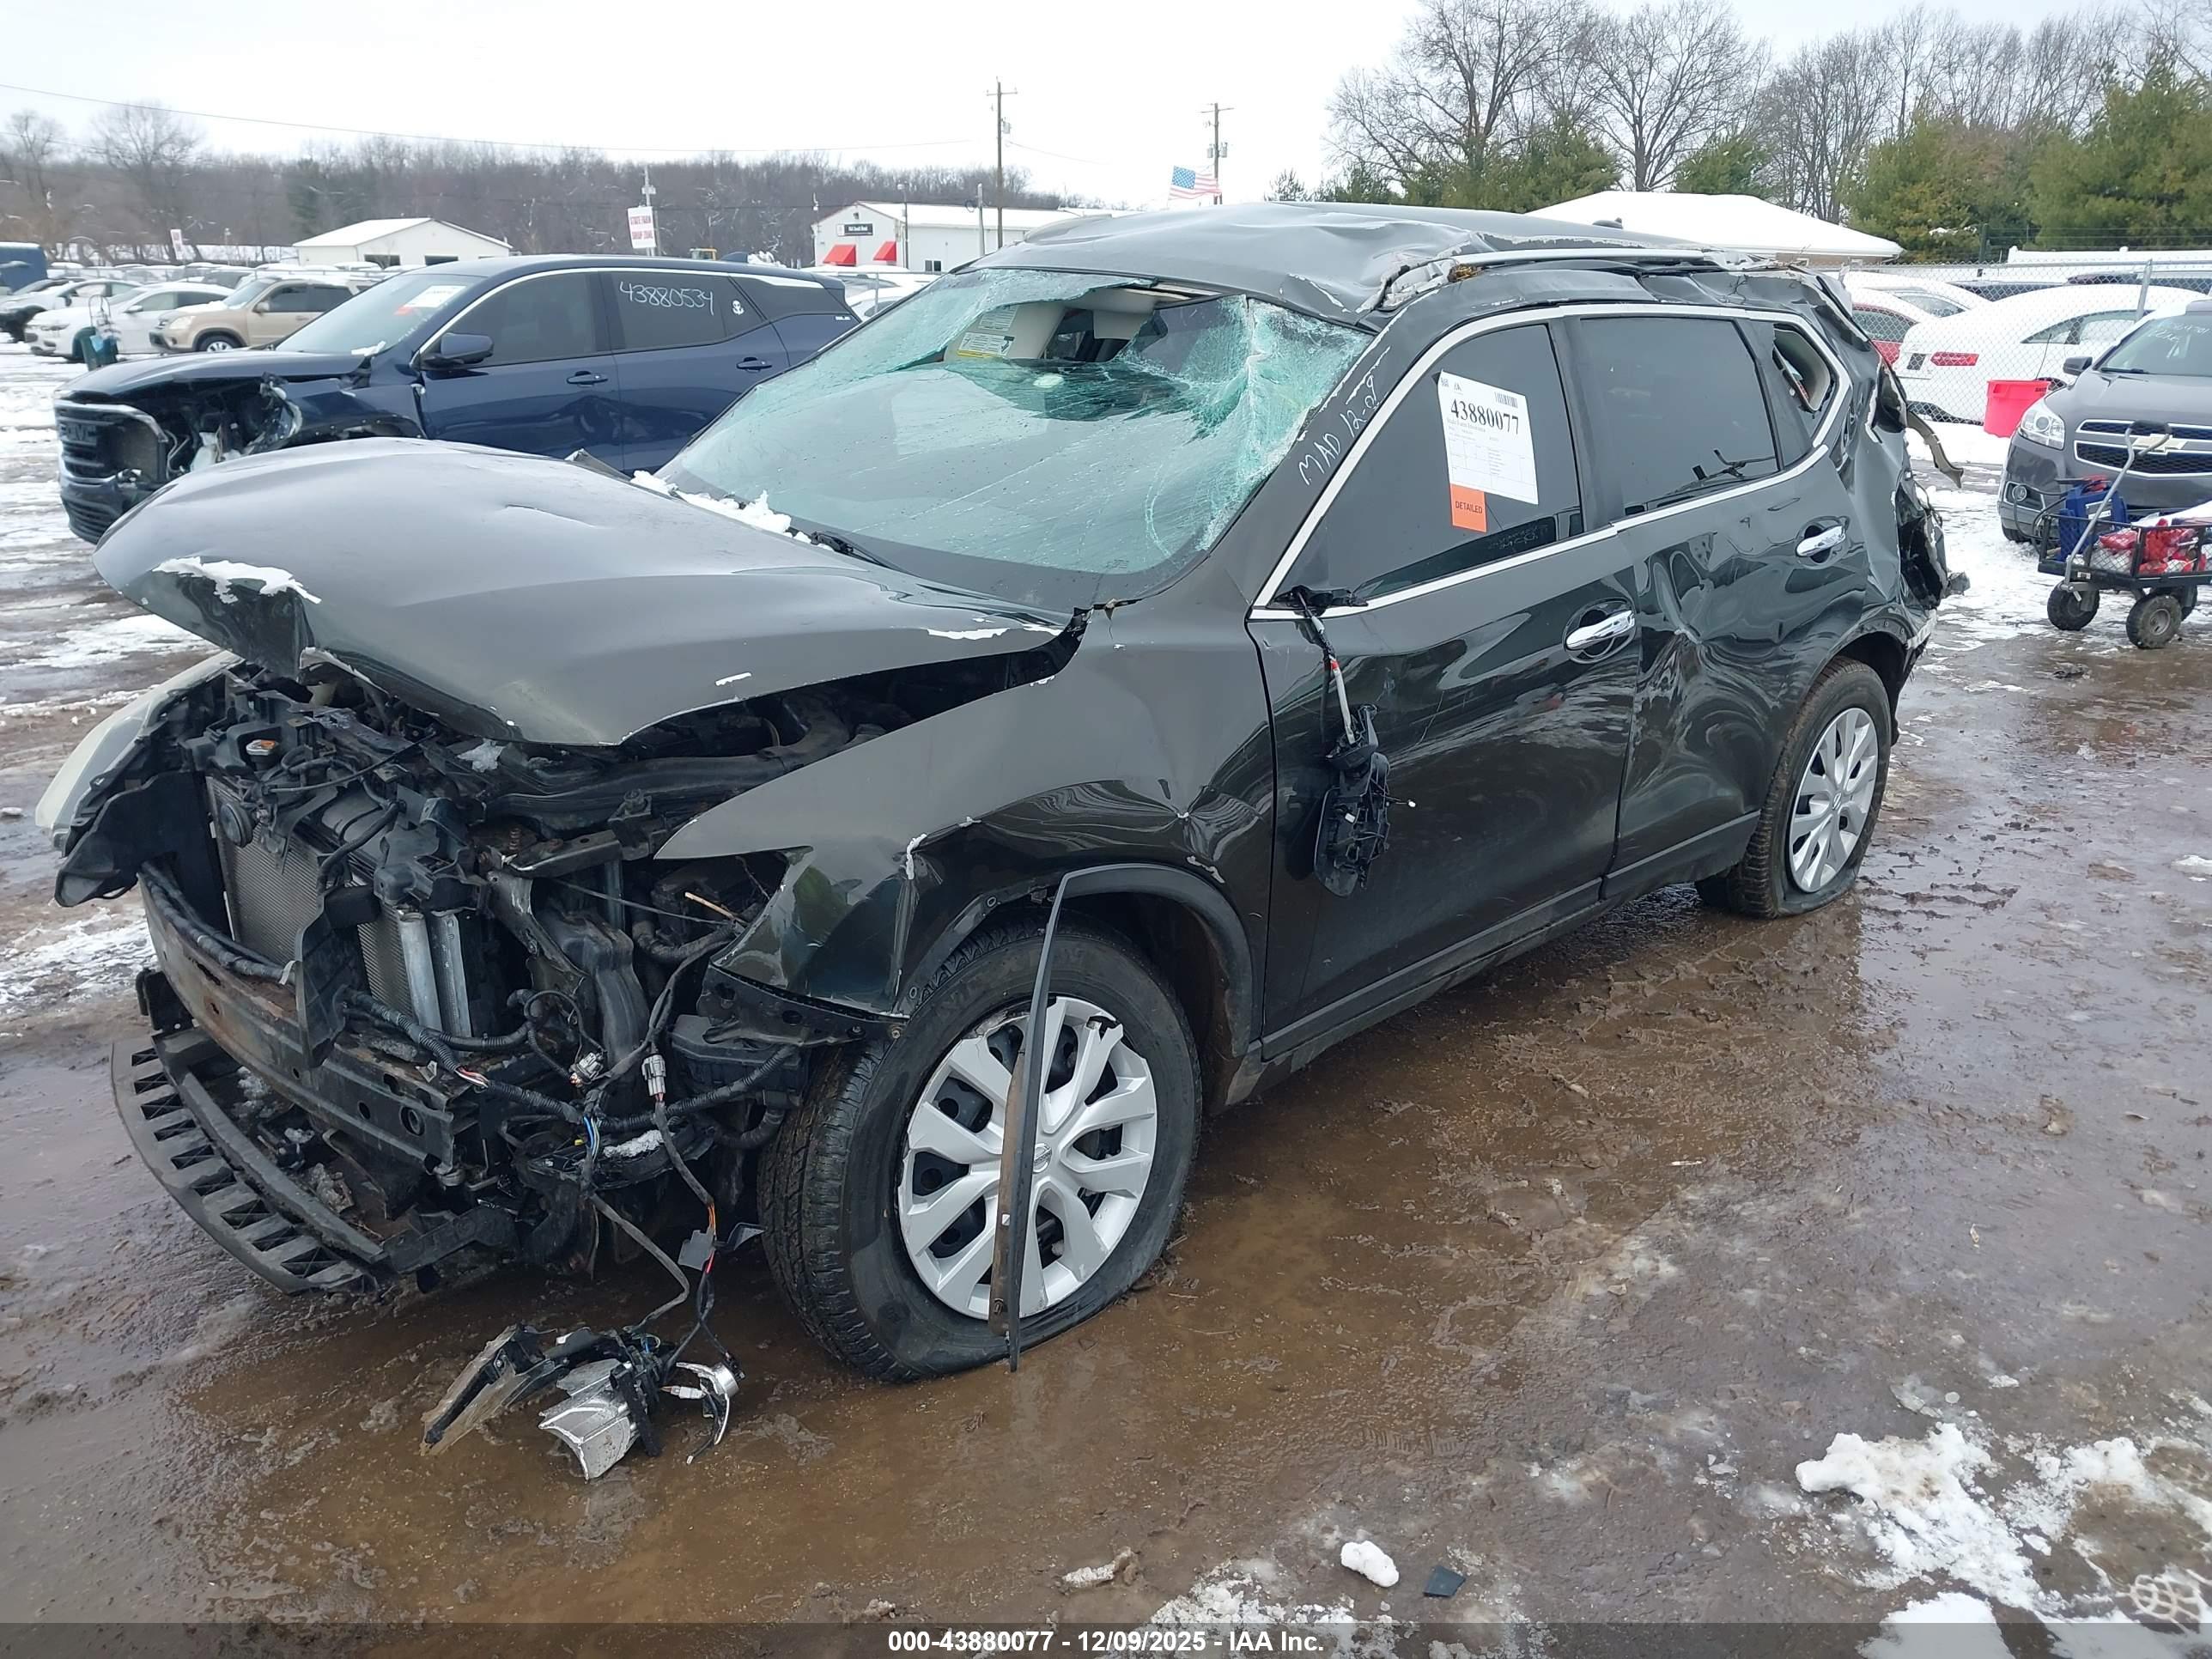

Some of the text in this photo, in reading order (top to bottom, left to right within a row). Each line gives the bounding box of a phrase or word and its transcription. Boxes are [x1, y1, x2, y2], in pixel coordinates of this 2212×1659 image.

[620, 281, 714, 316] 43880534
[1450, 398, 1519, 435] 43880077
[1298, 433, 1340, 486] MAD
[1455, 501, 1483, 514] DETAILED
